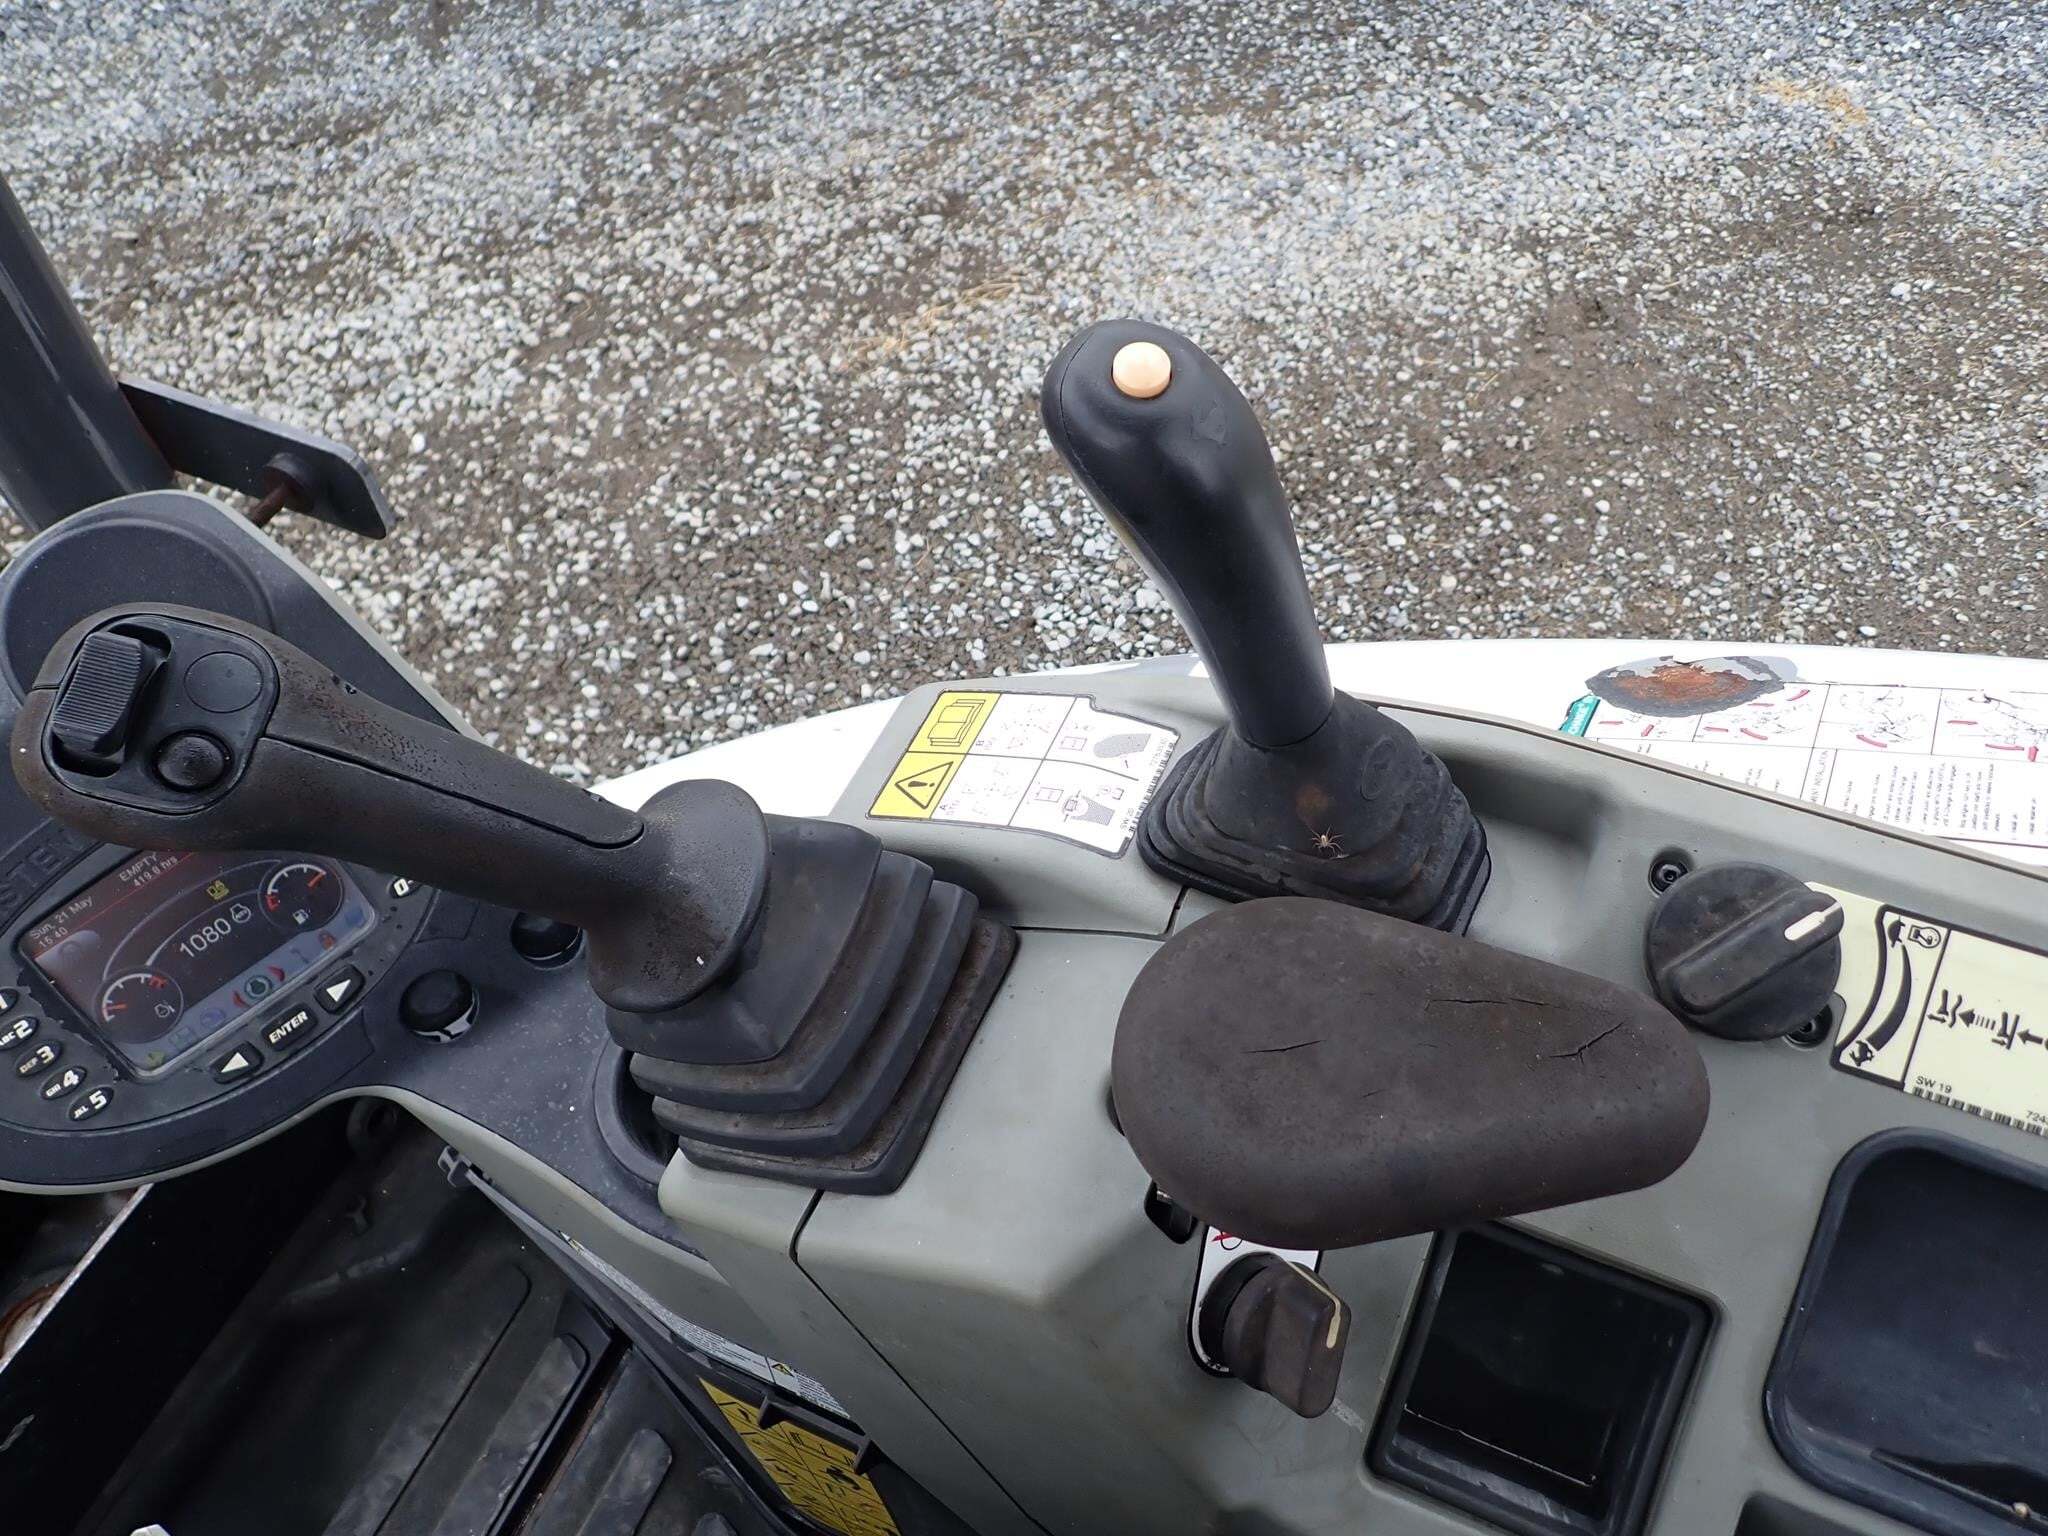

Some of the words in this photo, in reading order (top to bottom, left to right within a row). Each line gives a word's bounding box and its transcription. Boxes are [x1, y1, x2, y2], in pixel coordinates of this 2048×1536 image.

[119, 852, 157, 882] EMPTY
[161, 855, 178, 870] hrs
[55, 911, 69, 924] 21
[69, 895, 93, 914] May
[179, 917, 231, 958] 1080
[13, 1019, 32, 1039] 2
[269, 1011, 308, 1043] ENTER
[36, 1045, 55, 1063] 3
[63, 1070, 79, 1087] 4
[1916, 1075, 1936, 1088] SW
[1940, 1083, 1952, 1094] 19
[88, 1090, 107, 1109] 5
